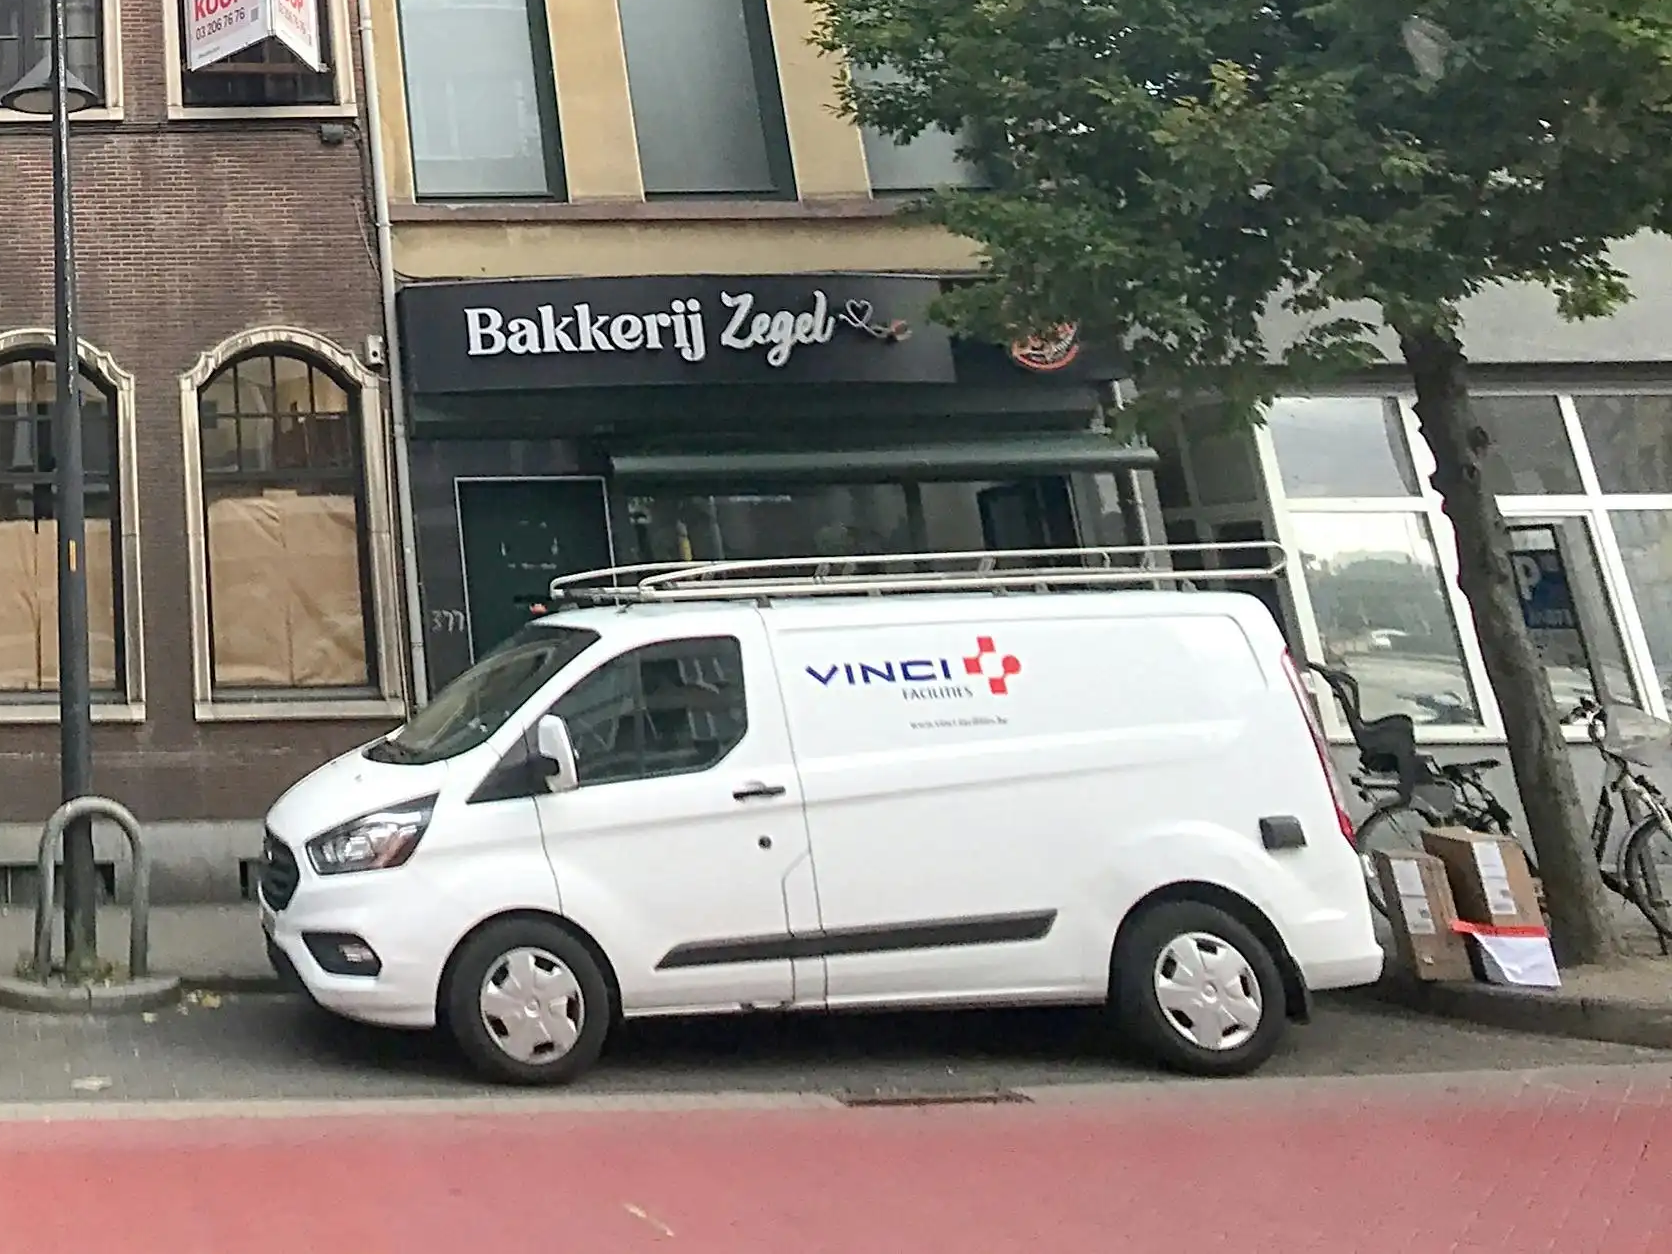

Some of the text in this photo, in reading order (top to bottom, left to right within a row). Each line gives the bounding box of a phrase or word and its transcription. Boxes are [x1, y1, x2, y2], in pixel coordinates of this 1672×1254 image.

[195, 6, 246, 41] 03 206 76 76
[463, 289, 835, 368] Bakkerij Zegel
[430, 608, 465, 634] 377
[804, 656, 953, 687] VINCI
[901, 685, 975, 702] FACILITIES
